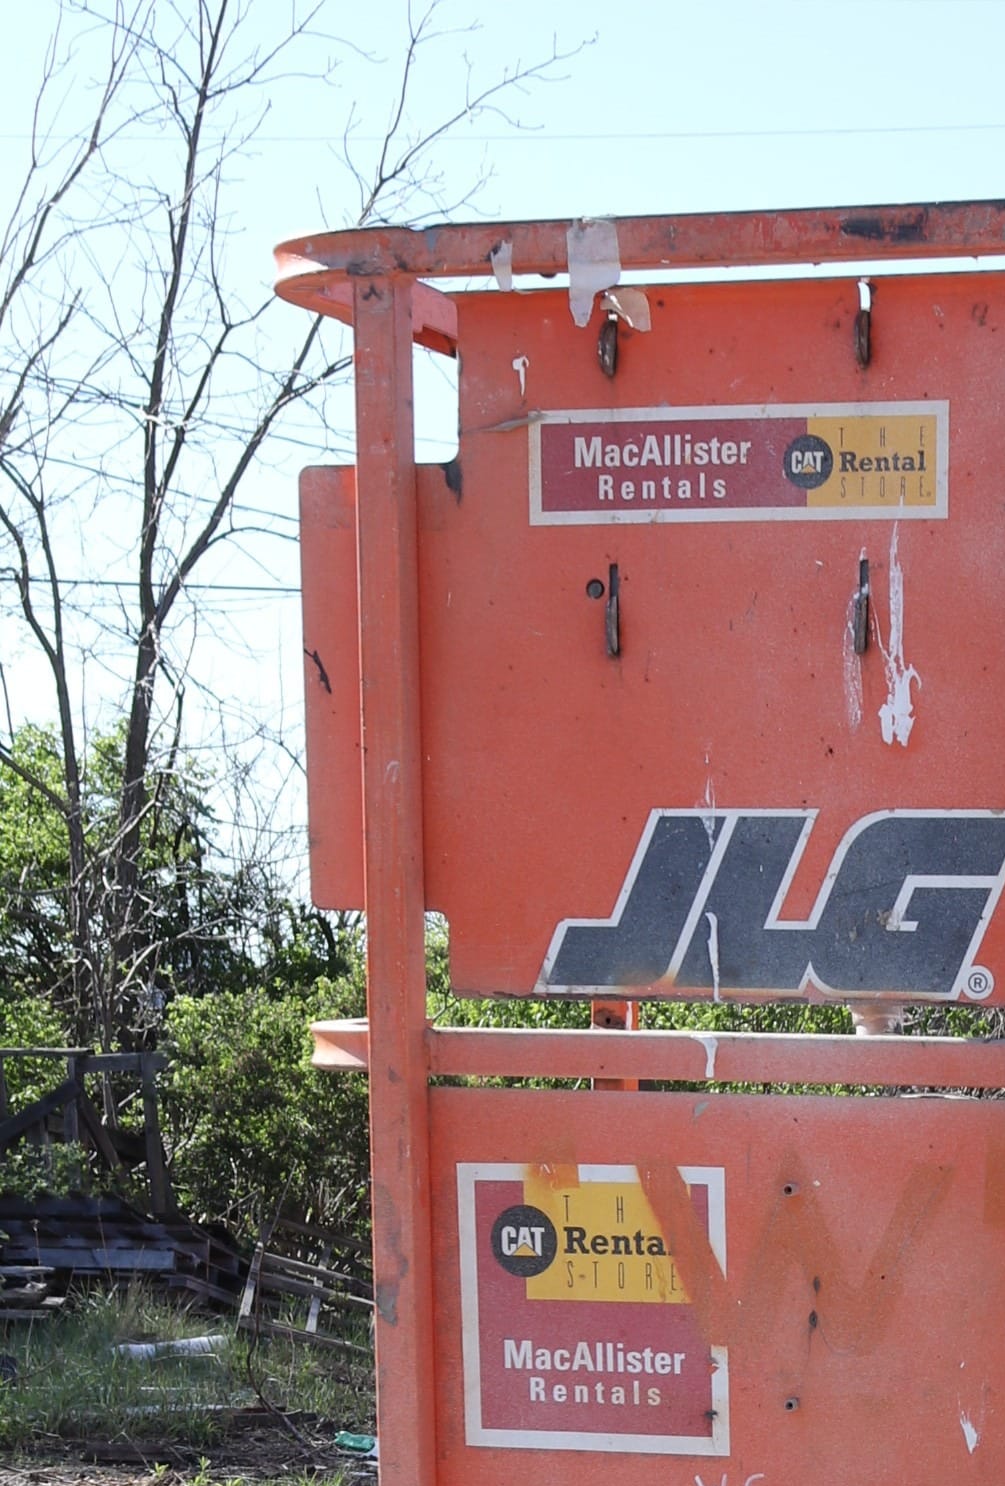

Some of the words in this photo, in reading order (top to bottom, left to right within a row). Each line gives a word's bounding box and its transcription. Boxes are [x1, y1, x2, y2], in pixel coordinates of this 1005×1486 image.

[574, 435, 752, 469] MacAllister
[839, 426, 927, 448] THE
[790, 450, 824, 474] CAT
[838, 450, 928, 473] Rental
[597, 473, 728, 500] Rentals
[500, 1226, 546, 1257] CAT
[562, 1225, 673, 1257] Renta
[503, 1339, 686, 1375] MacAllister
[529, 1376, 662, 1406] Rentals
